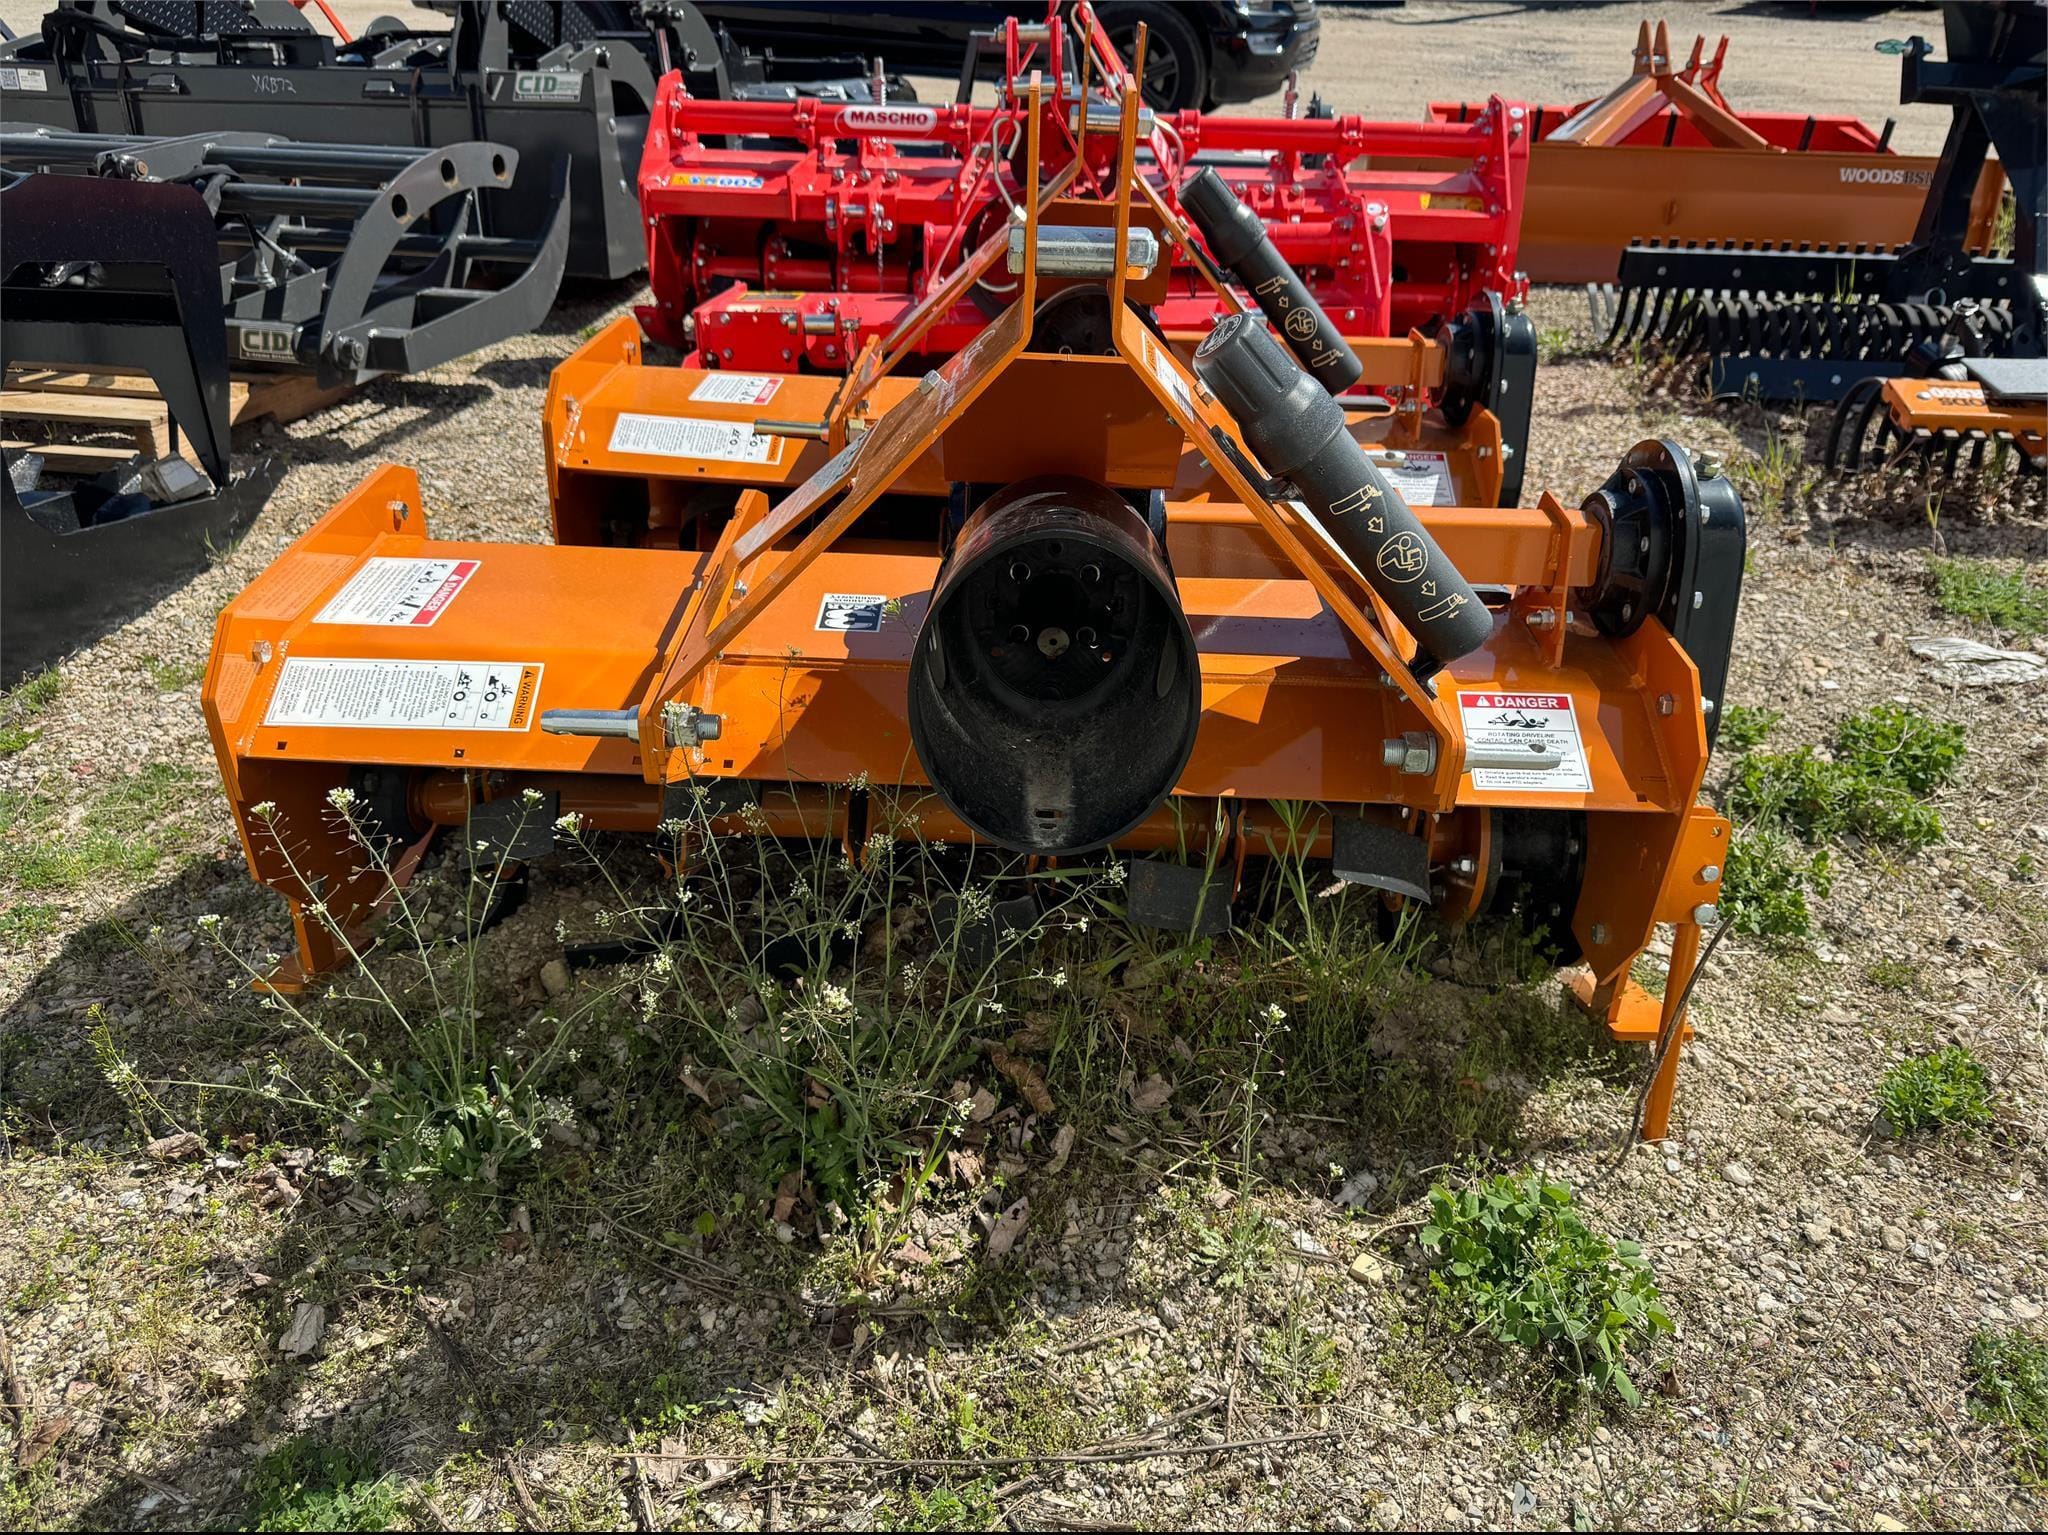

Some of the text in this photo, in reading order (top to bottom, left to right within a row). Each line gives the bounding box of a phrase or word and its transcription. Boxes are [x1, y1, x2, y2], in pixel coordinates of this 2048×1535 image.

[518, 76, 557, 92] CID
[850, 111, 928, 126] MASCHIO
[1840, 168, 1905, 184] WOODS
[244, 331, 288, 351] CID
[422, 582, 459, 611] DANGER
[514, 681, 532, 724] WARNING
[1494, 697, 1559, 708] DANGER
